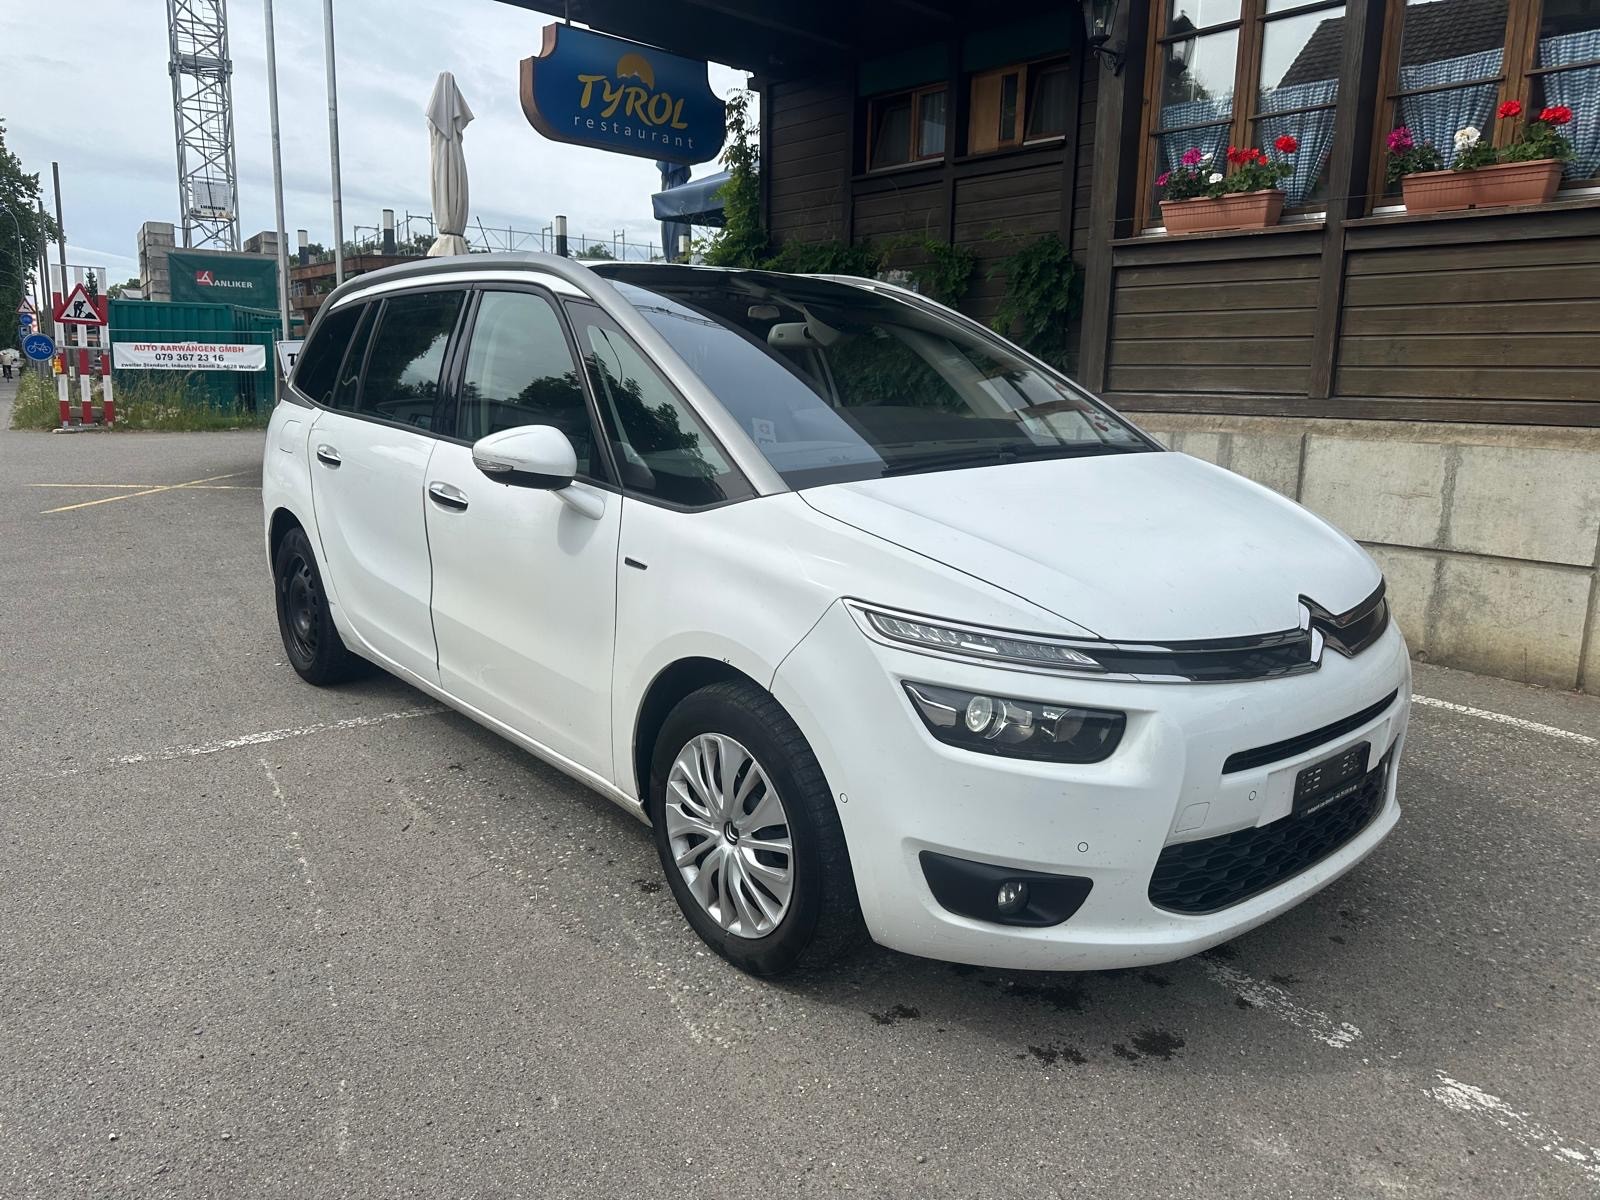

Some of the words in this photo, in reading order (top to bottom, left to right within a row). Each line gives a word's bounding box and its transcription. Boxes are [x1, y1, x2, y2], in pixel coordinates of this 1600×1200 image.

[577, 73, 688, 130] TYROL
[574, 114, 694, 150] restaurant
[214, 280, 253, 289] ANLIKER
[134, 344, 158, 352] AUTO
[218, 345, 245, 353] GMBH
[155, 353, 174, 361] 079
[176, 353, 194, 361] 367
[197, 354, 209, 362] 23
[212, 354, 225, 362] 16
